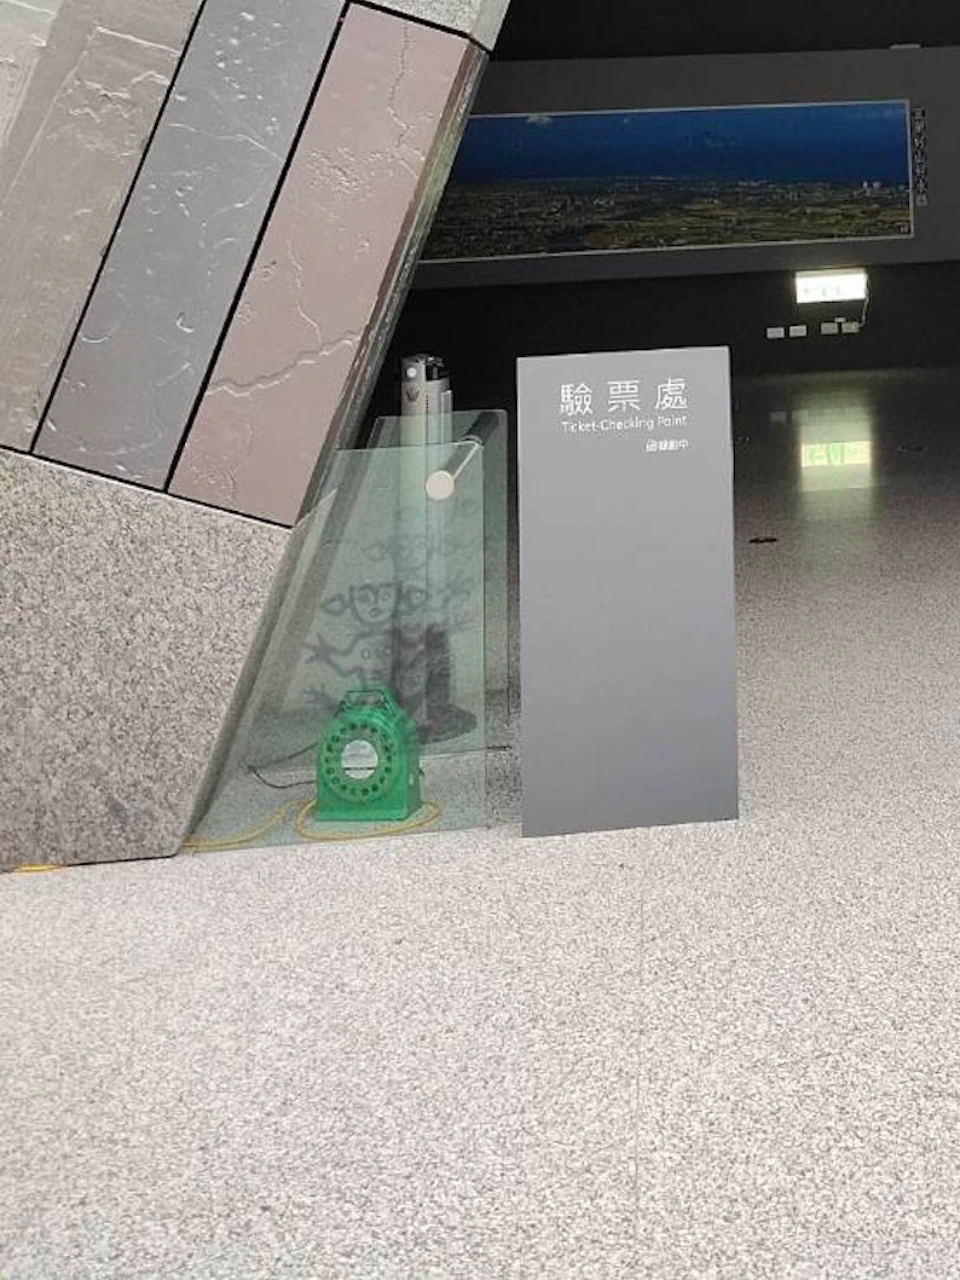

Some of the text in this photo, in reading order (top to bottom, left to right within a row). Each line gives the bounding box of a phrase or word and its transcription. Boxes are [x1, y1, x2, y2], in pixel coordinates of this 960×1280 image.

[560, 377, 688, 416] 驗票處
[561, 414, 688, 433] Ticket-Checking Point
